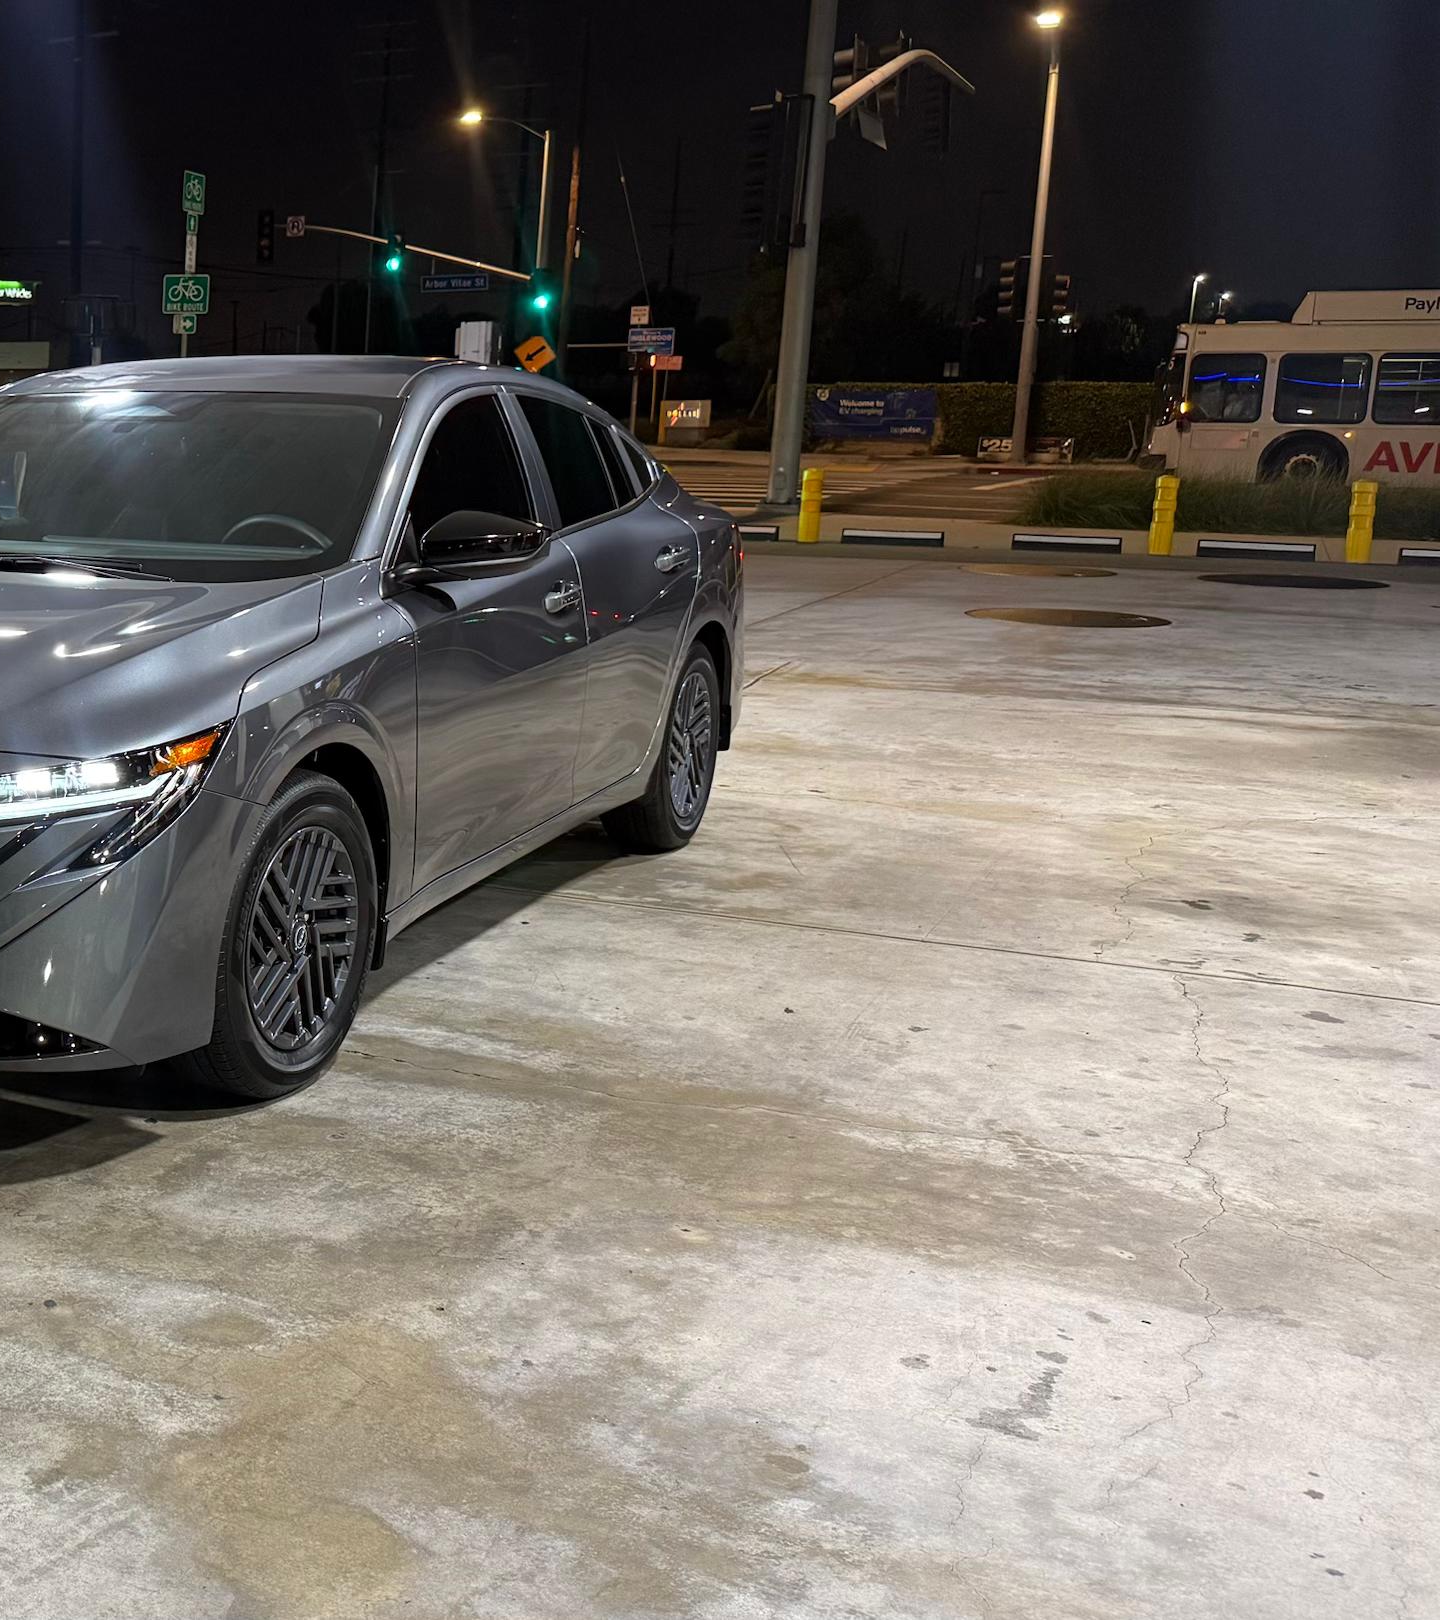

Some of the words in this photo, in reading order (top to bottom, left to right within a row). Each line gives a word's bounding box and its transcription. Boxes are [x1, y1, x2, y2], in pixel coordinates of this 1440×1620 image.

[424, 279, 448, 289] Arbor
[474, 277, 485, 287] St
[5, 287, 33, 299] Vehicles
[166, 302, 182, 312] BIKE
[183, 302, 204, 312] ROUTE
[840, 399, 875, 408] Welcome
[876, 400, 885, 408] to
